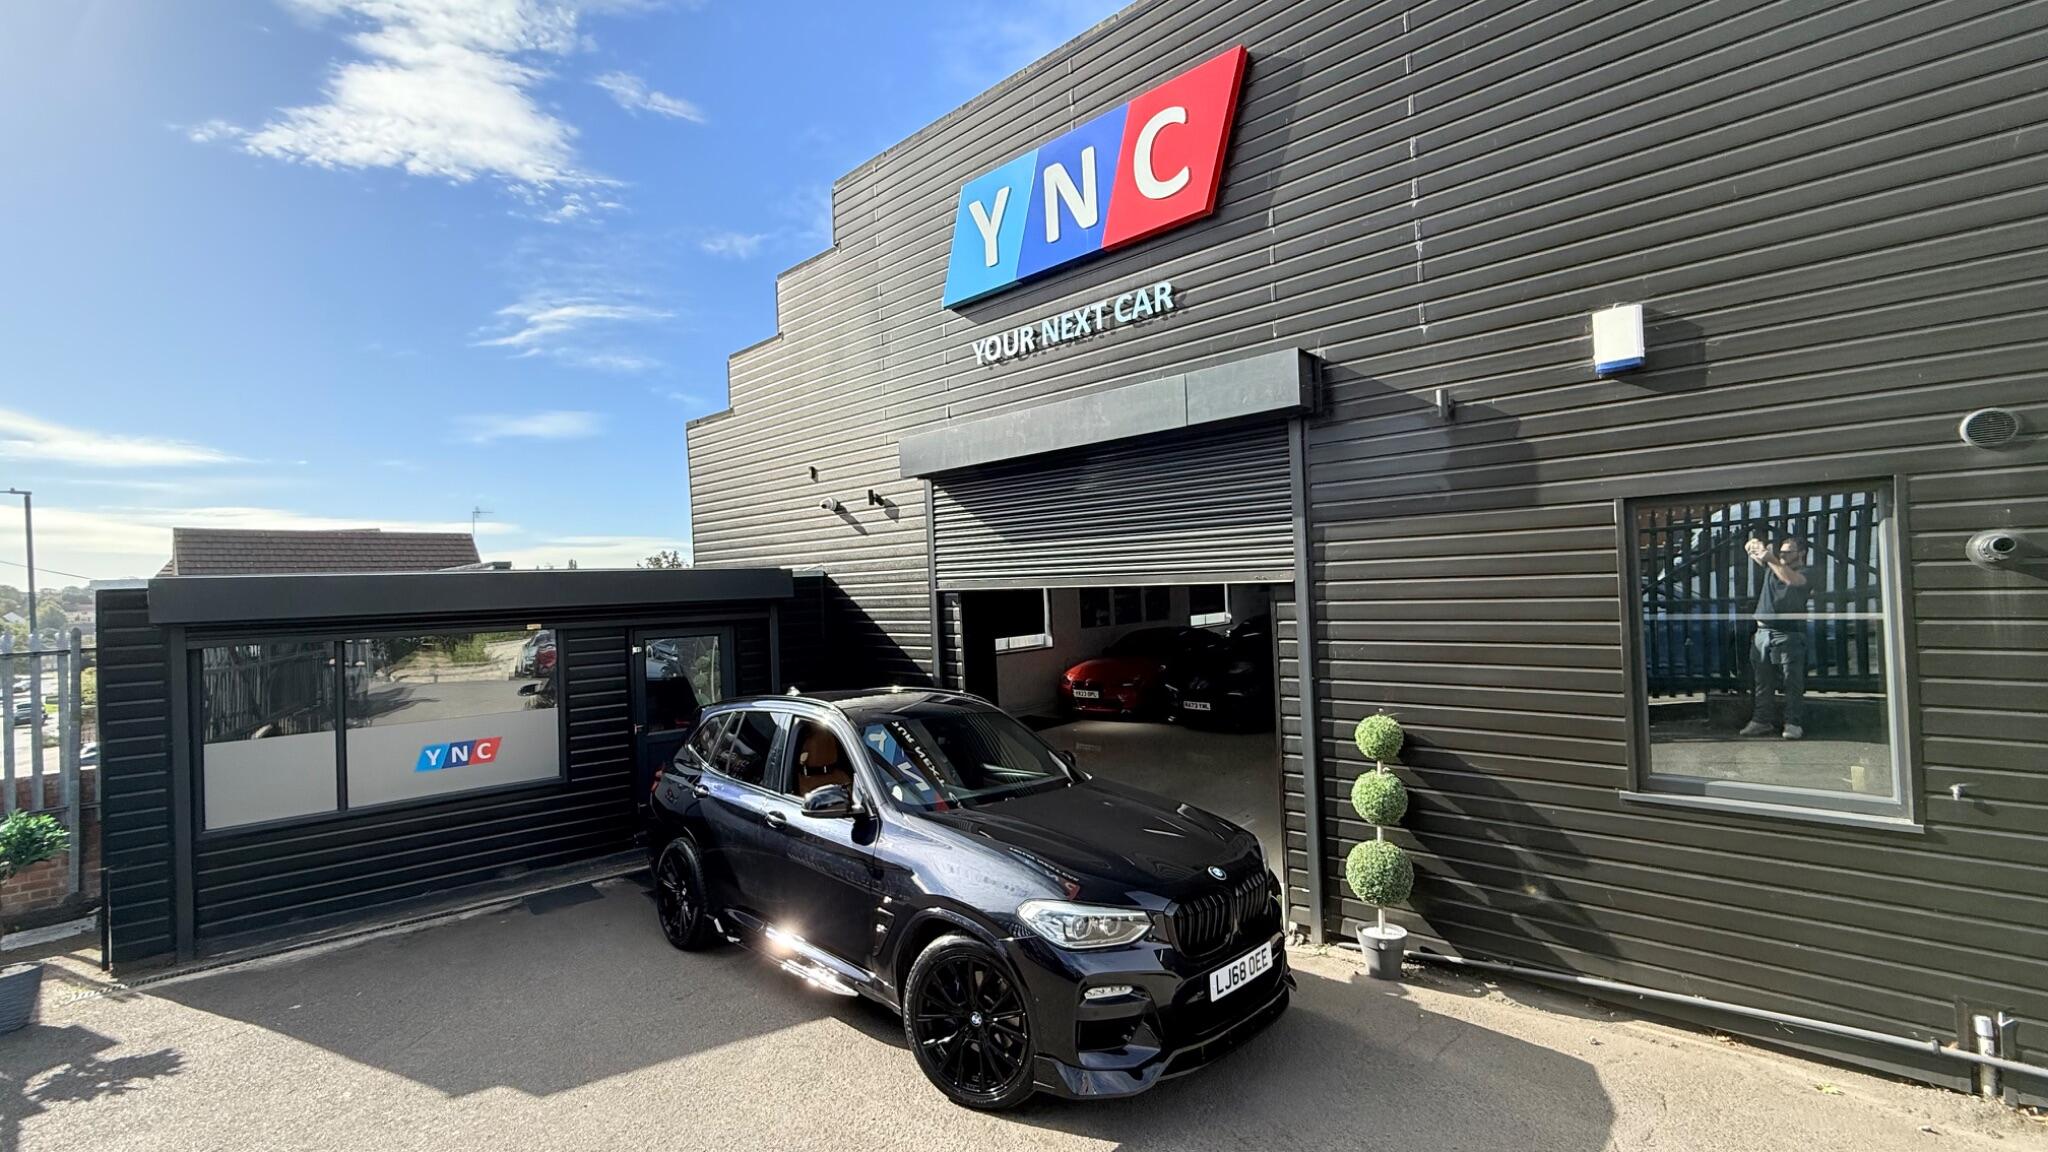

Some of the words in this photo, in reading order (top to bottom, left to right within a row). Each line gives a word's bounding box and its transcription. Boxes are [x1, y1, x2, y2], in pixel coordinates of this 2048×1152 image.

[968, 105, 1190, 268] YNC
[971, 324, 1036, 366] YOUR
[1041, 302, 1107, 346] NEXT
[1114, 280, 1176, 324] CAR
[425, 742, 492, 767] YNC
[1216, 960, 1247, 995] LJ68
